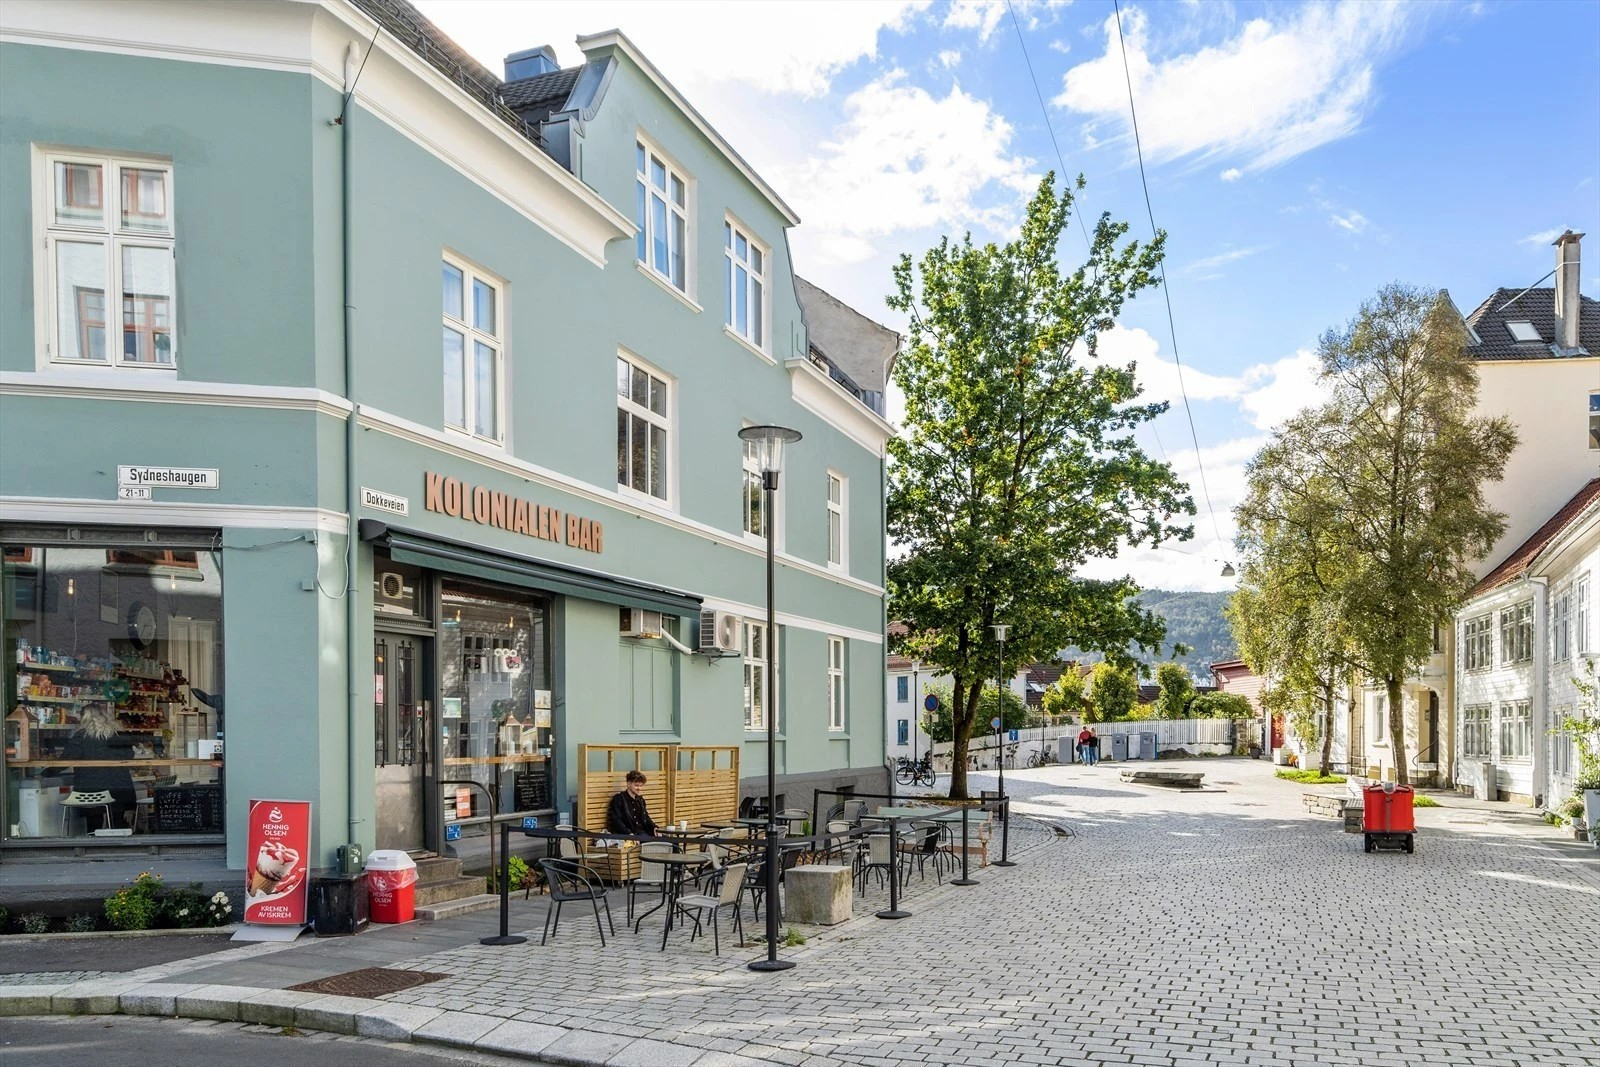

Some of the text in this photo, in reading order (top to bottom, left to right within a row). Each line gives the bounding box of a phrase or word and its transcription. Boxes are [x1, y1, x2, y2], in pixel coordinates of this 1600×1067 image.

[130, 468, 207, 485] Sydneshaugen
[366, 491, 405, 512] Dokkeveien
[424, 471, 603, 554] KOLONIALEN BAR
[262, 823, 290, 831] HENNIG
